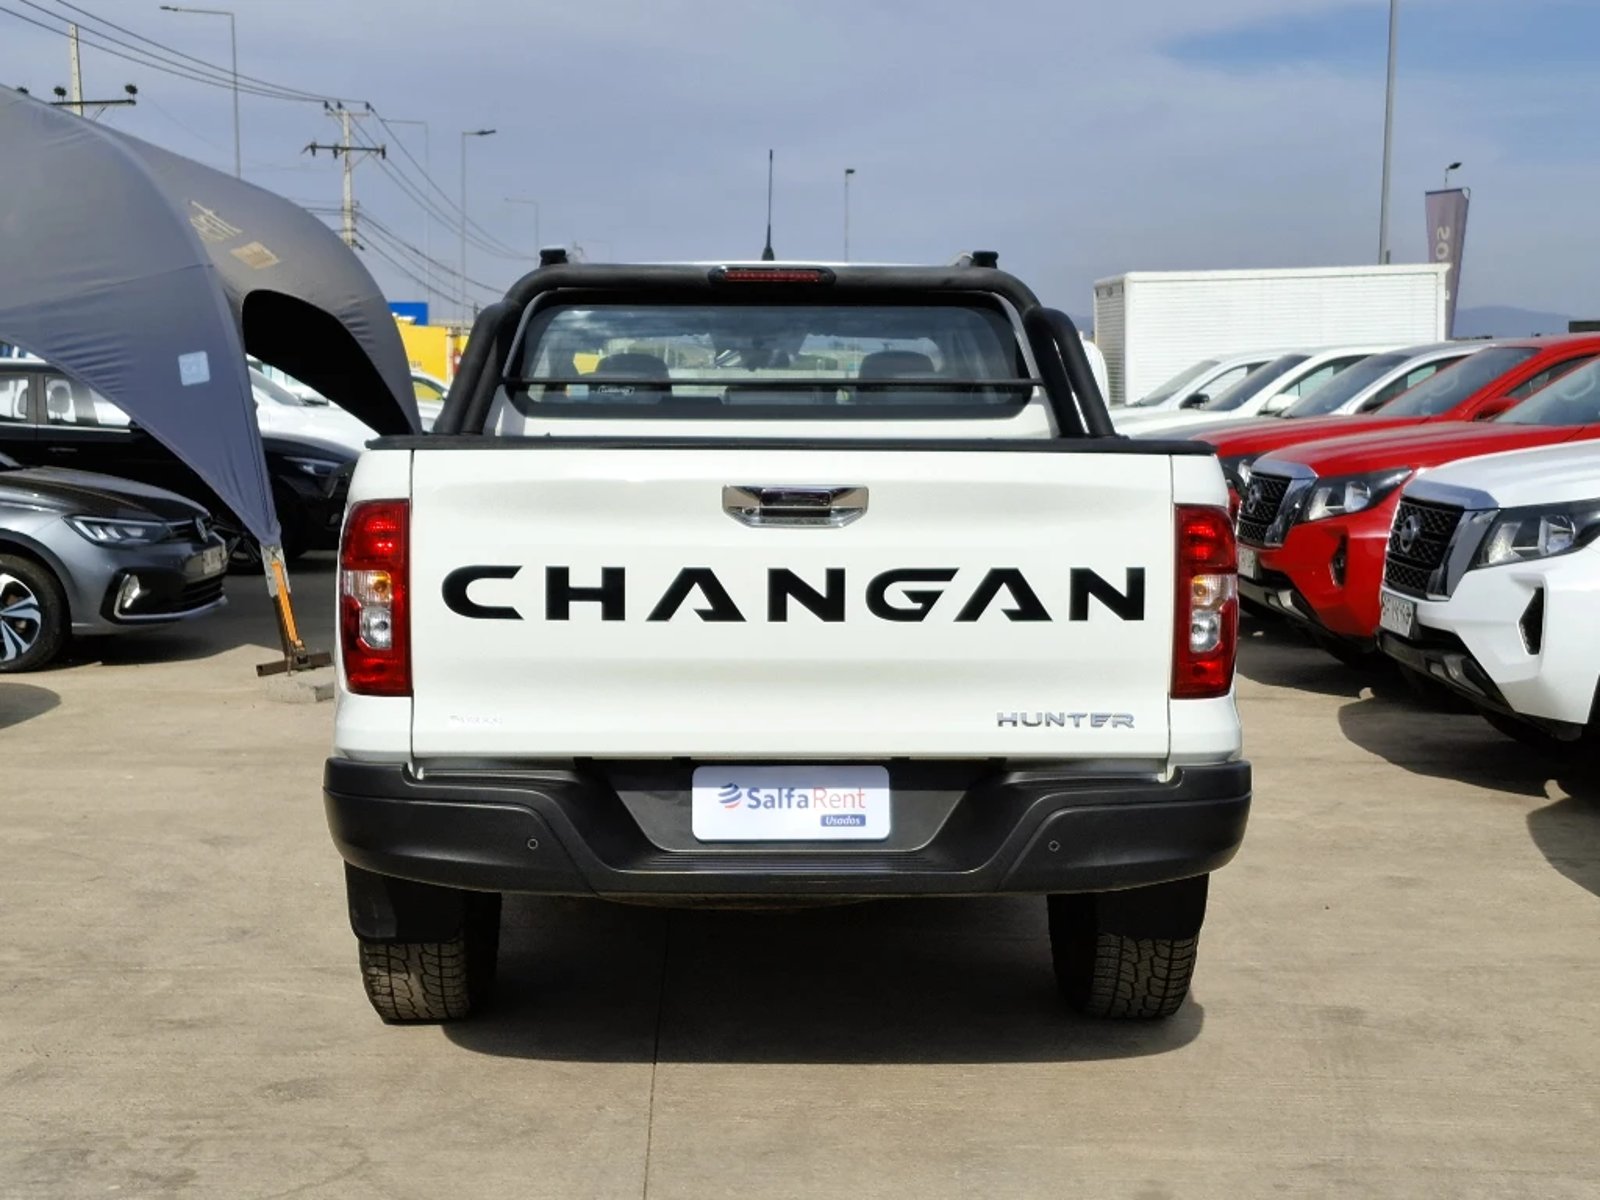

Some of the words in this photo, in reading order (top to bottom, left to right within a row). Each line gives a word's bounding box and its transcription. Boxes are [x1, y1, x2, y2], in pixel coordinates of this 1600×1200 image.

[441, 565, 1146, 622] CHANGAN
[996, 711, 1135, 728] HUNTER
[825, 815, 861, 826] Usados
